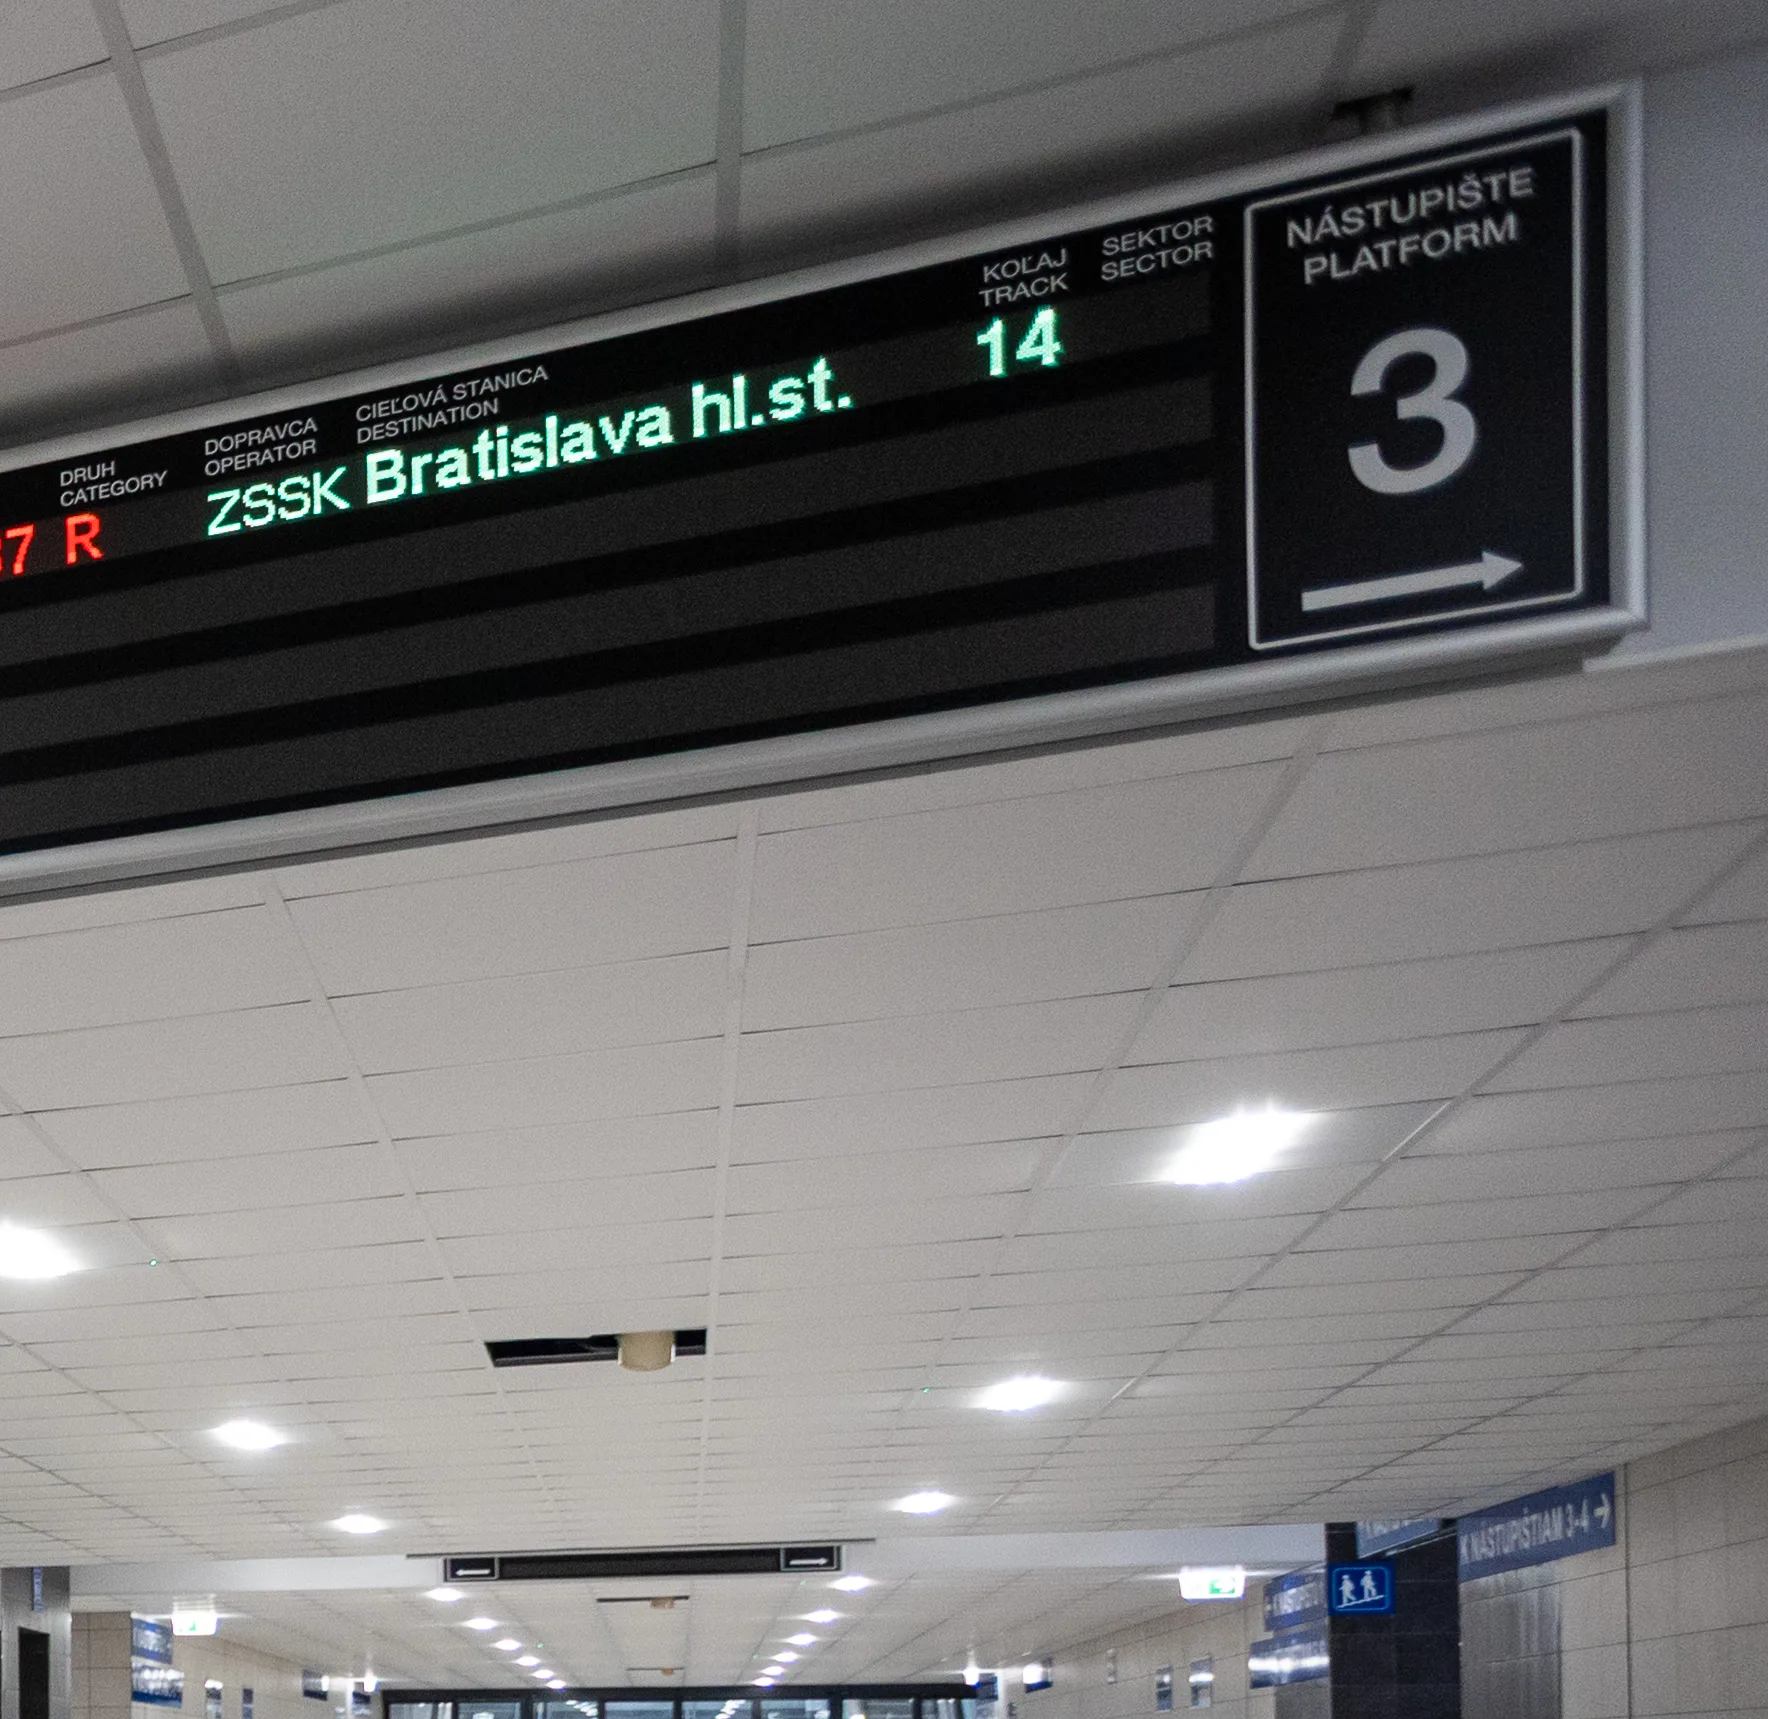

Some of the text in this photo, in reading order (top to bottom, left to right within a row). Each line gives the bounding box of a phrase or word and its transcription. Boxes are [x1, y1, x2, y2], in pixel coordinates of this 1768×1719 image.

[1286, 166, 1535, 248] NÁSTUPIŠTE
[1102, 215, 1213, 256] SEKTOR
[1304, 211, 1519, 285] PLATFORM
[982, 248, 1067, 283] KOĽAJ
[1101, 241, 1213, 281] SECTOR
[978, 272, 1069, 307] TRACK
[356, 365, 550, 422] CIEĽOVÁ STANICA
[1347, 328, 1477, 494] 3
[64, 512, 104, 565] R
[206, 465, 351, 536] ZSSK
[366, 404, 674, 504] Bratislava
[691, 355, 854, 438] hl.st.
[976, 305, 1063, 378] 14
[204, 417, 318, 455] DOPRAVCA
[357, 398, 499, 444] DESTINATION
[60, 461, 115, 487] DRUH
[204, 439, 316, 476] OPERATOR
[60, 471, 168, 507] CATEGORY
